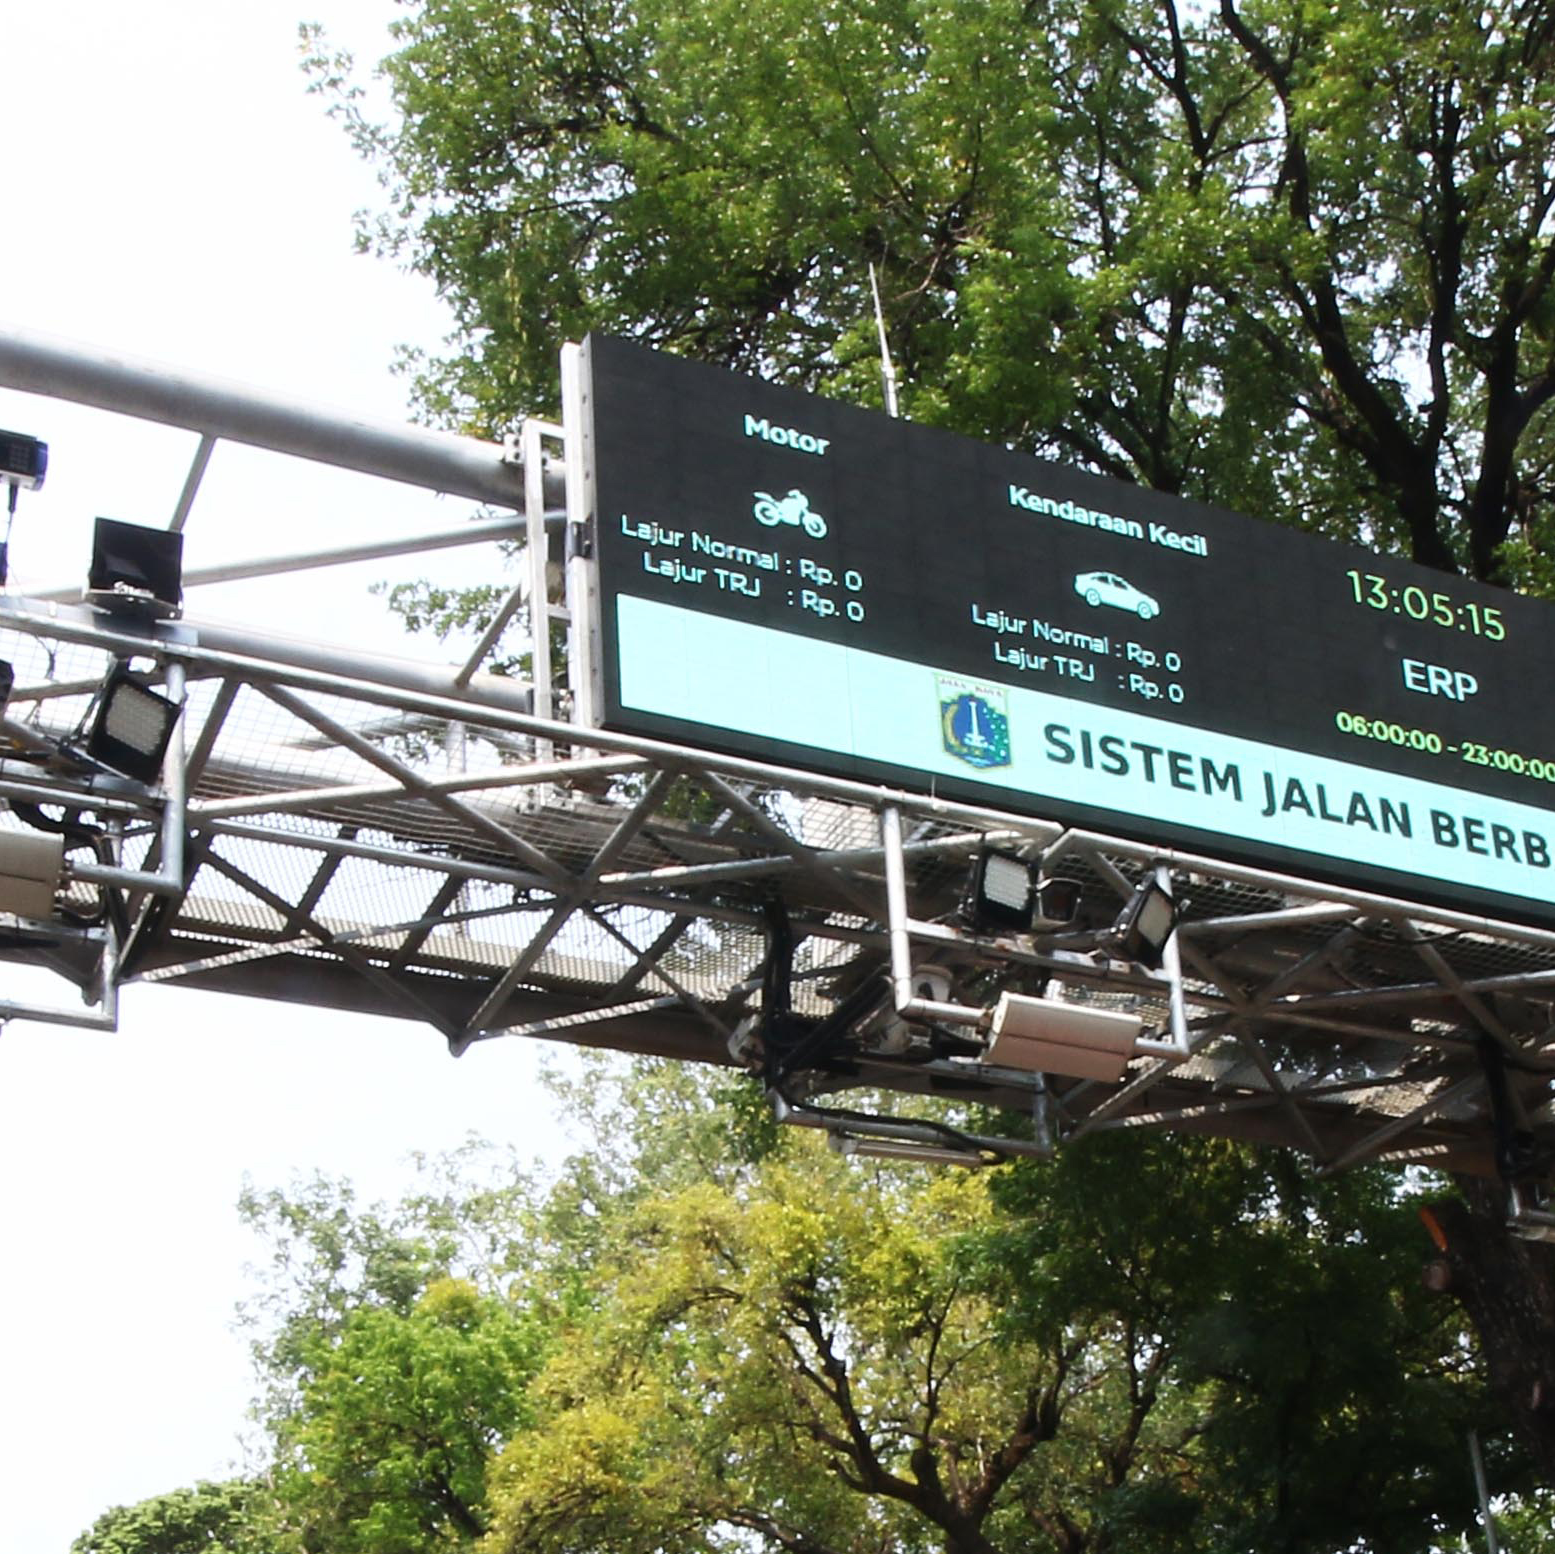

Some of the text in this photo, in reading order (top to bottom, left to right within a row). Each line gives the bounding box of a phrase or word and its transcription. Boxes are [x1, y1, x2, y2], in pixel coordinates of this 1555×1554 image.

[744, 414, 831, 456] Motor
[621, 514, 685, 548] Lajur
[691, 531, 780, 572] Normal
[798, 558, 839, 588] Rp.
[844, 570, 863, 591] 0
[1009, 484, 1209, 557] Kendaraan Kecil
[643, 551, 708, 584] Lajur
[713, 567, 761, 597] TRJ
[800, 589, 841, 618] Rp.
[846, 600, 865, 622] 0
[1346, 570, 1506, 641] 13:05:15
[971, 603, 1028, 634] Lajur
[1032, 618, 1110, 655] Normal
[1126, 641, 1161, 669] Rp.
[1165, 651, 1182, 672] 0
[994, 641, 1050, 671] Lajur
[1052, 655, 1095, 682] TRJ
[1129, 673, 1164, 700] Rp.
[1168, 683, 1185, 703] 0
[1402, 658, 1479, 702] ERP
[1335, 711, 1443, 754] 06:00:00
[1043, 723, 1243, 802] SISTEM
[1260, 770, 1414, 839] JALAN
